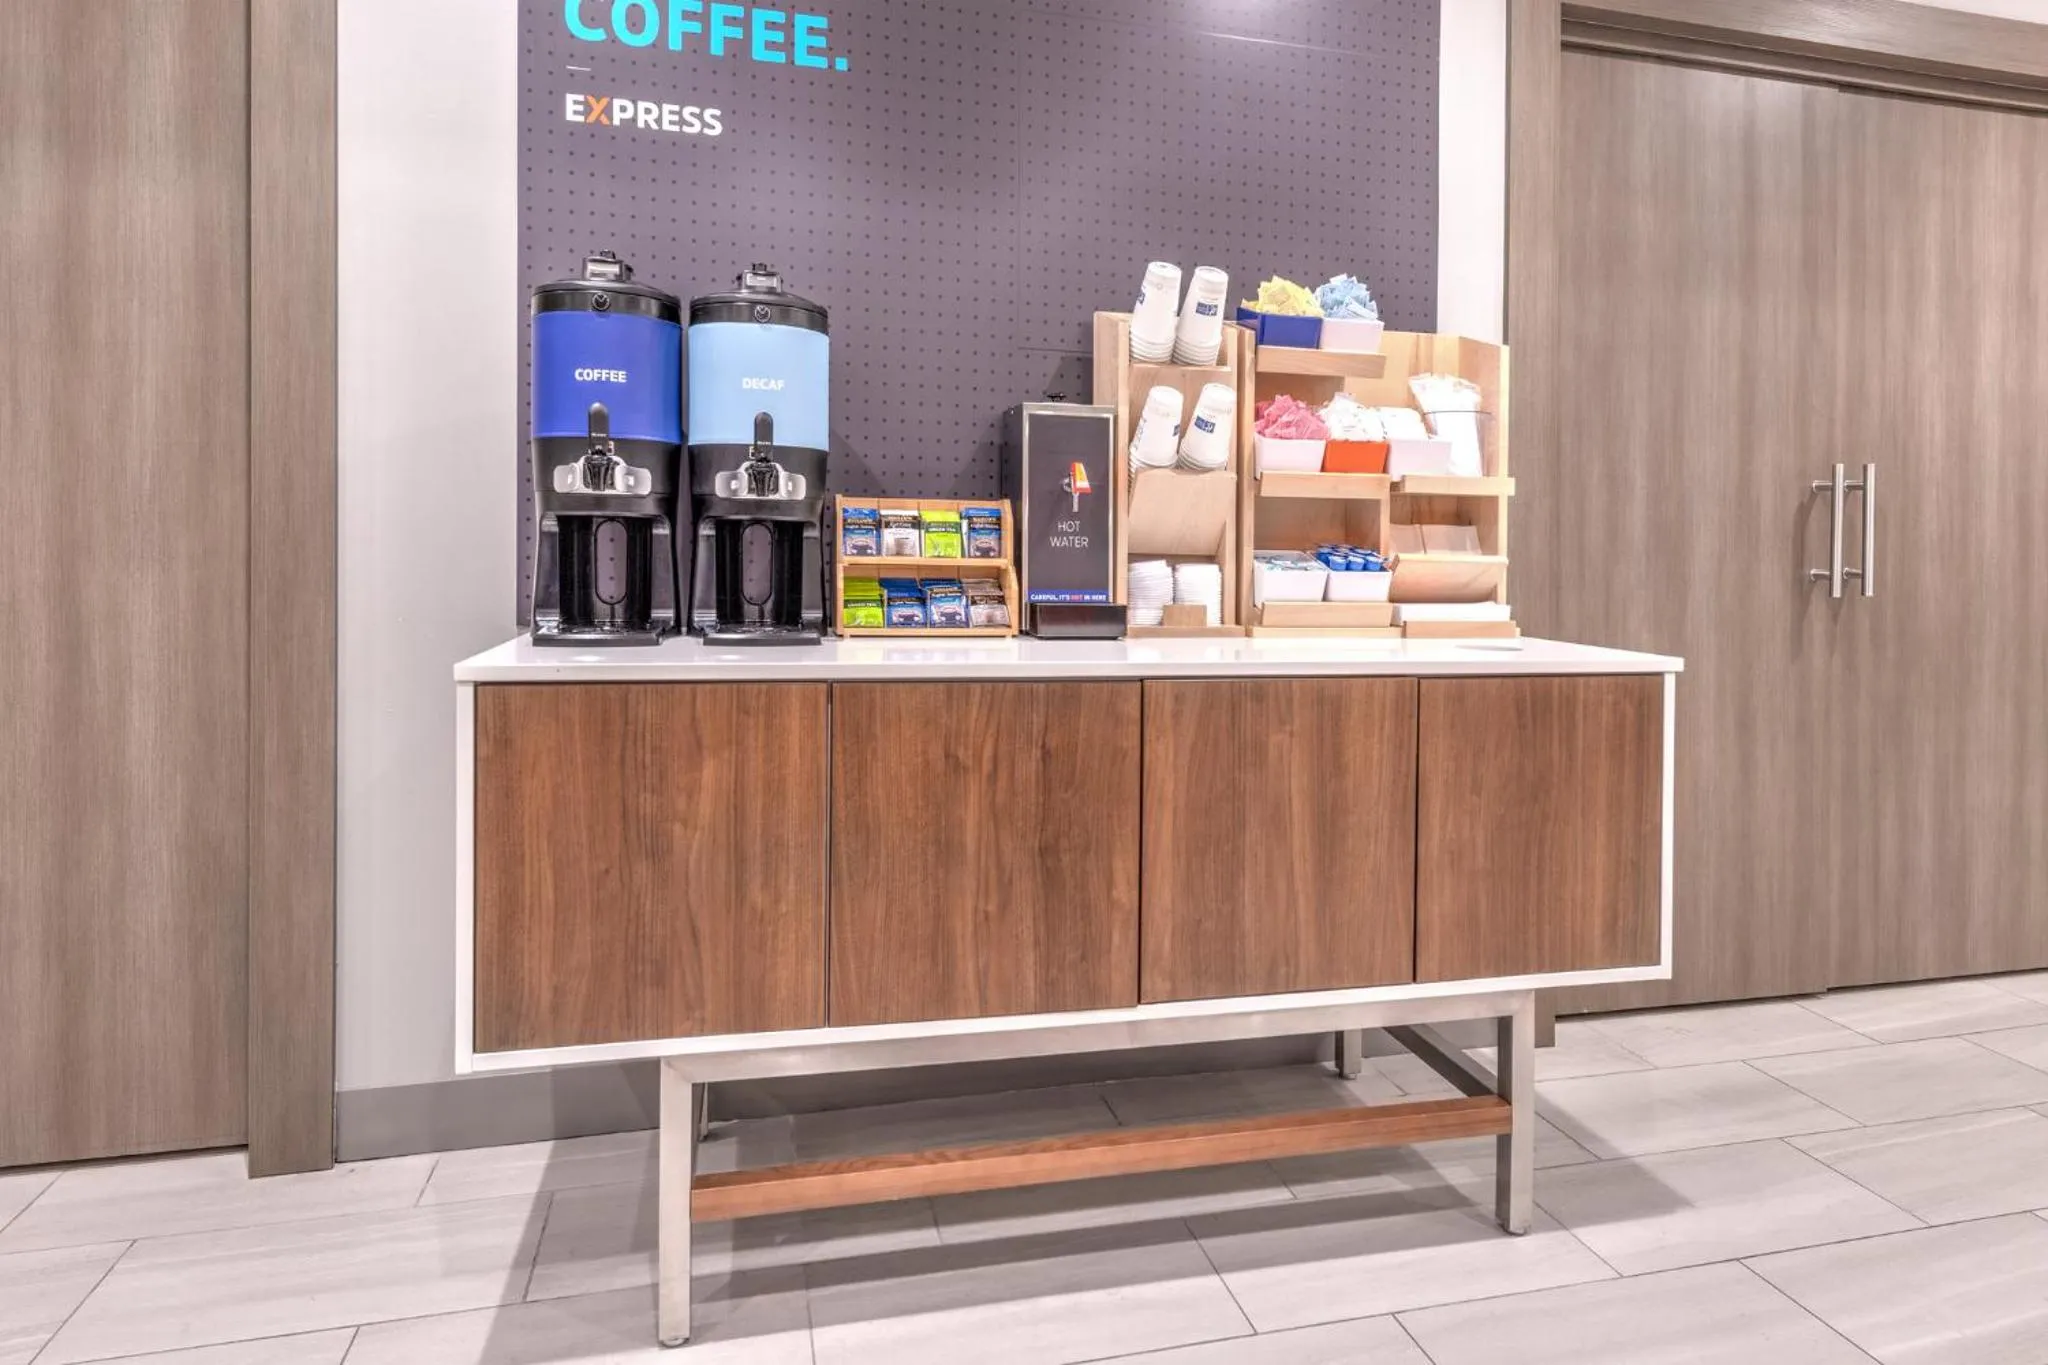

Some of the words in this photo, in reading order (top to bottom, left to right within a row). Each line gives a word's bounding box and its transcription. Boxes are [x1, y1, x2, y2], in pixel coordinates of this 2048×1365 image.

[564, 0, 850, 72] COFFEE.
[565, 93, 723, 136] EXPRESS
[574, 368, 628, 383] COFFEE
[742, 376, 785, 391] DECAF
[1058, 520, 1081, 532] HOT
[1049, 536, 1089, 548] WATER
